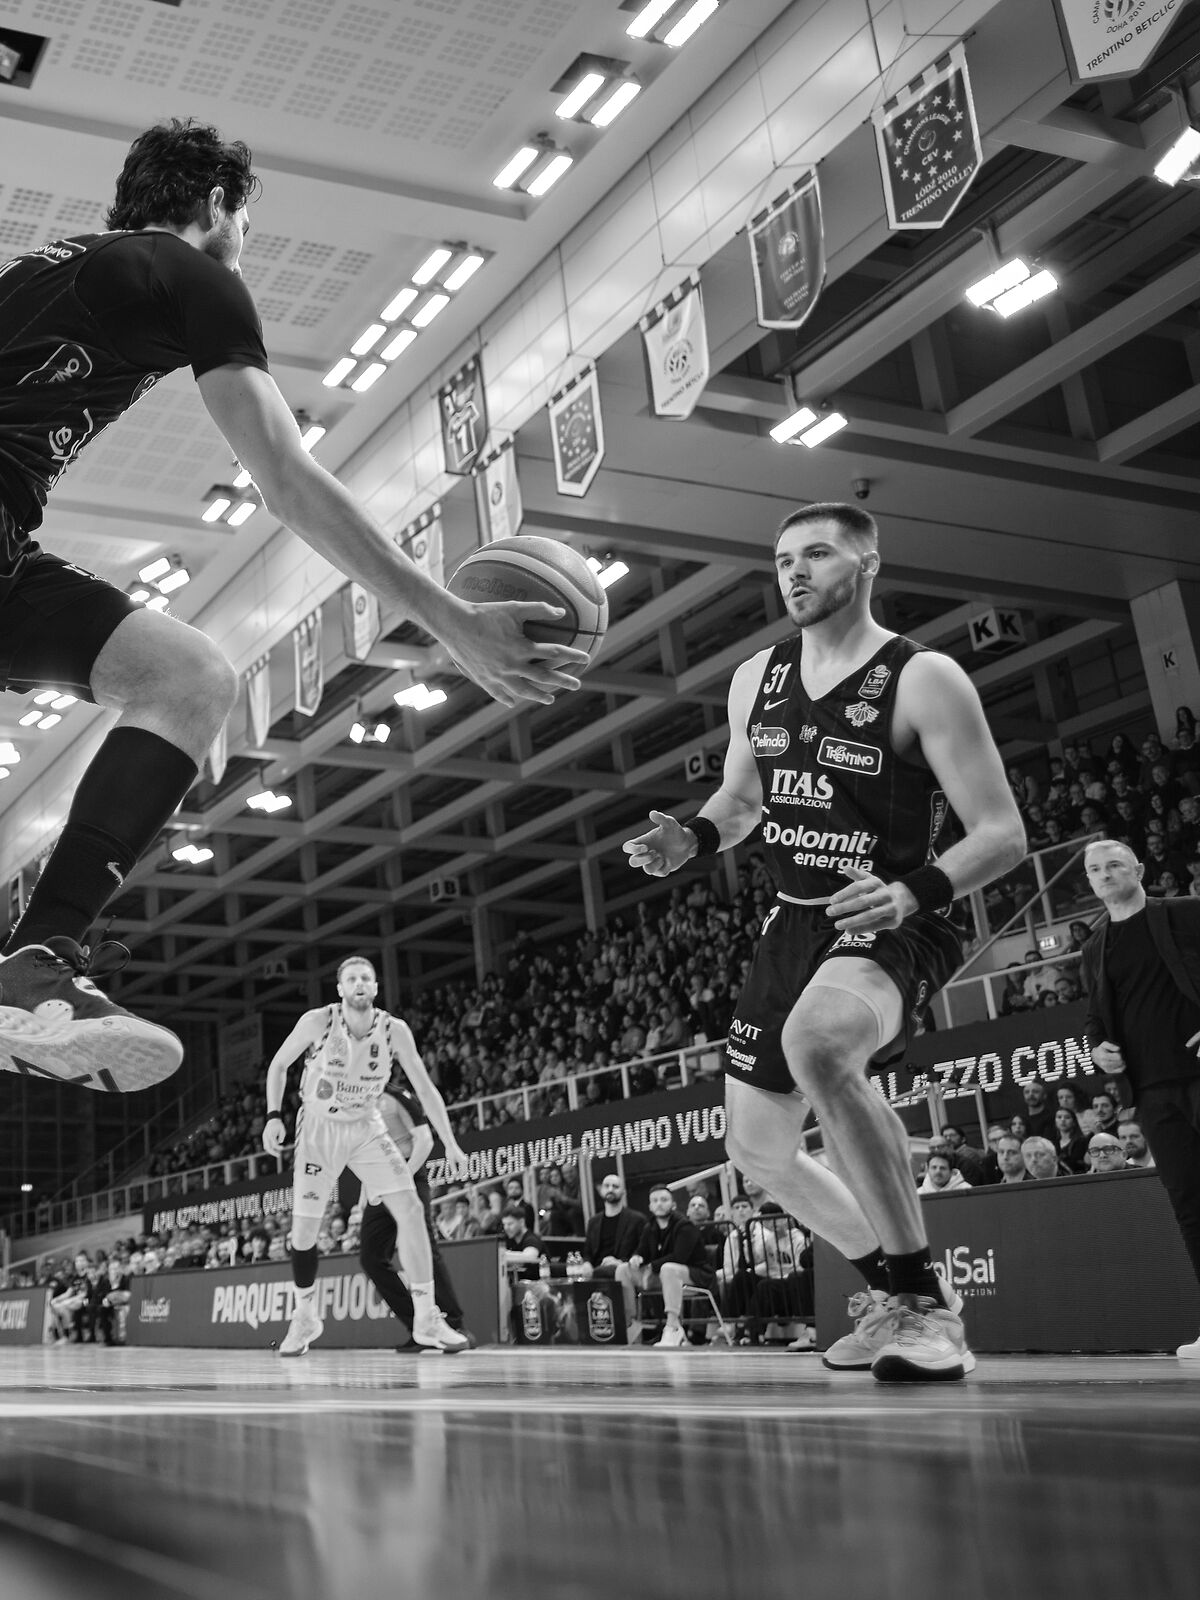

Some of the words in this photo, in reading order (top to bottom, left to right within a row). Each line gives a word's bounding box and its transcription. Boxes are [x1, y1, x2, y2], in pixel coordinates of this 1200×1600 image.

[1106, 20, 1128, 34] DOHA
[1129, 1, 1146, 21] 2010
[1086, 33, 1133, 71] TRENTINO
[1135, 0, 1176, 35] BETCLIC
[921, 148, 939, 166] CEV
[937, 165, 958, 185] 2010
[900, 188, 942, 221] TRENTINO
[942, 163, 974, 192] VOLLEY
[972, 616, 994, 643] K
[998, 613, 1020, 636] K
[1163, 651, 1175, 668] K
[763, 663, 792, 694] 31
[751, 733, 787, 748] Melinda
[689, 755, 701, 774] C
[826, 745, 875, 767] TRENTINO
[770, 768, 834, 800] ITAS
[770, 795, 832, 809] ASSICURAZIONI
[765, 821, 878, 855] Dolomiti
[793, 851, 874, 875] energia
[1011, 1035, 1095, 1087] CON
[495, 1142, 524, 1176] CHI
[581, 1115, 672, 1160] QUANDO
[211, 1280, 296, 1330] PARQUET
